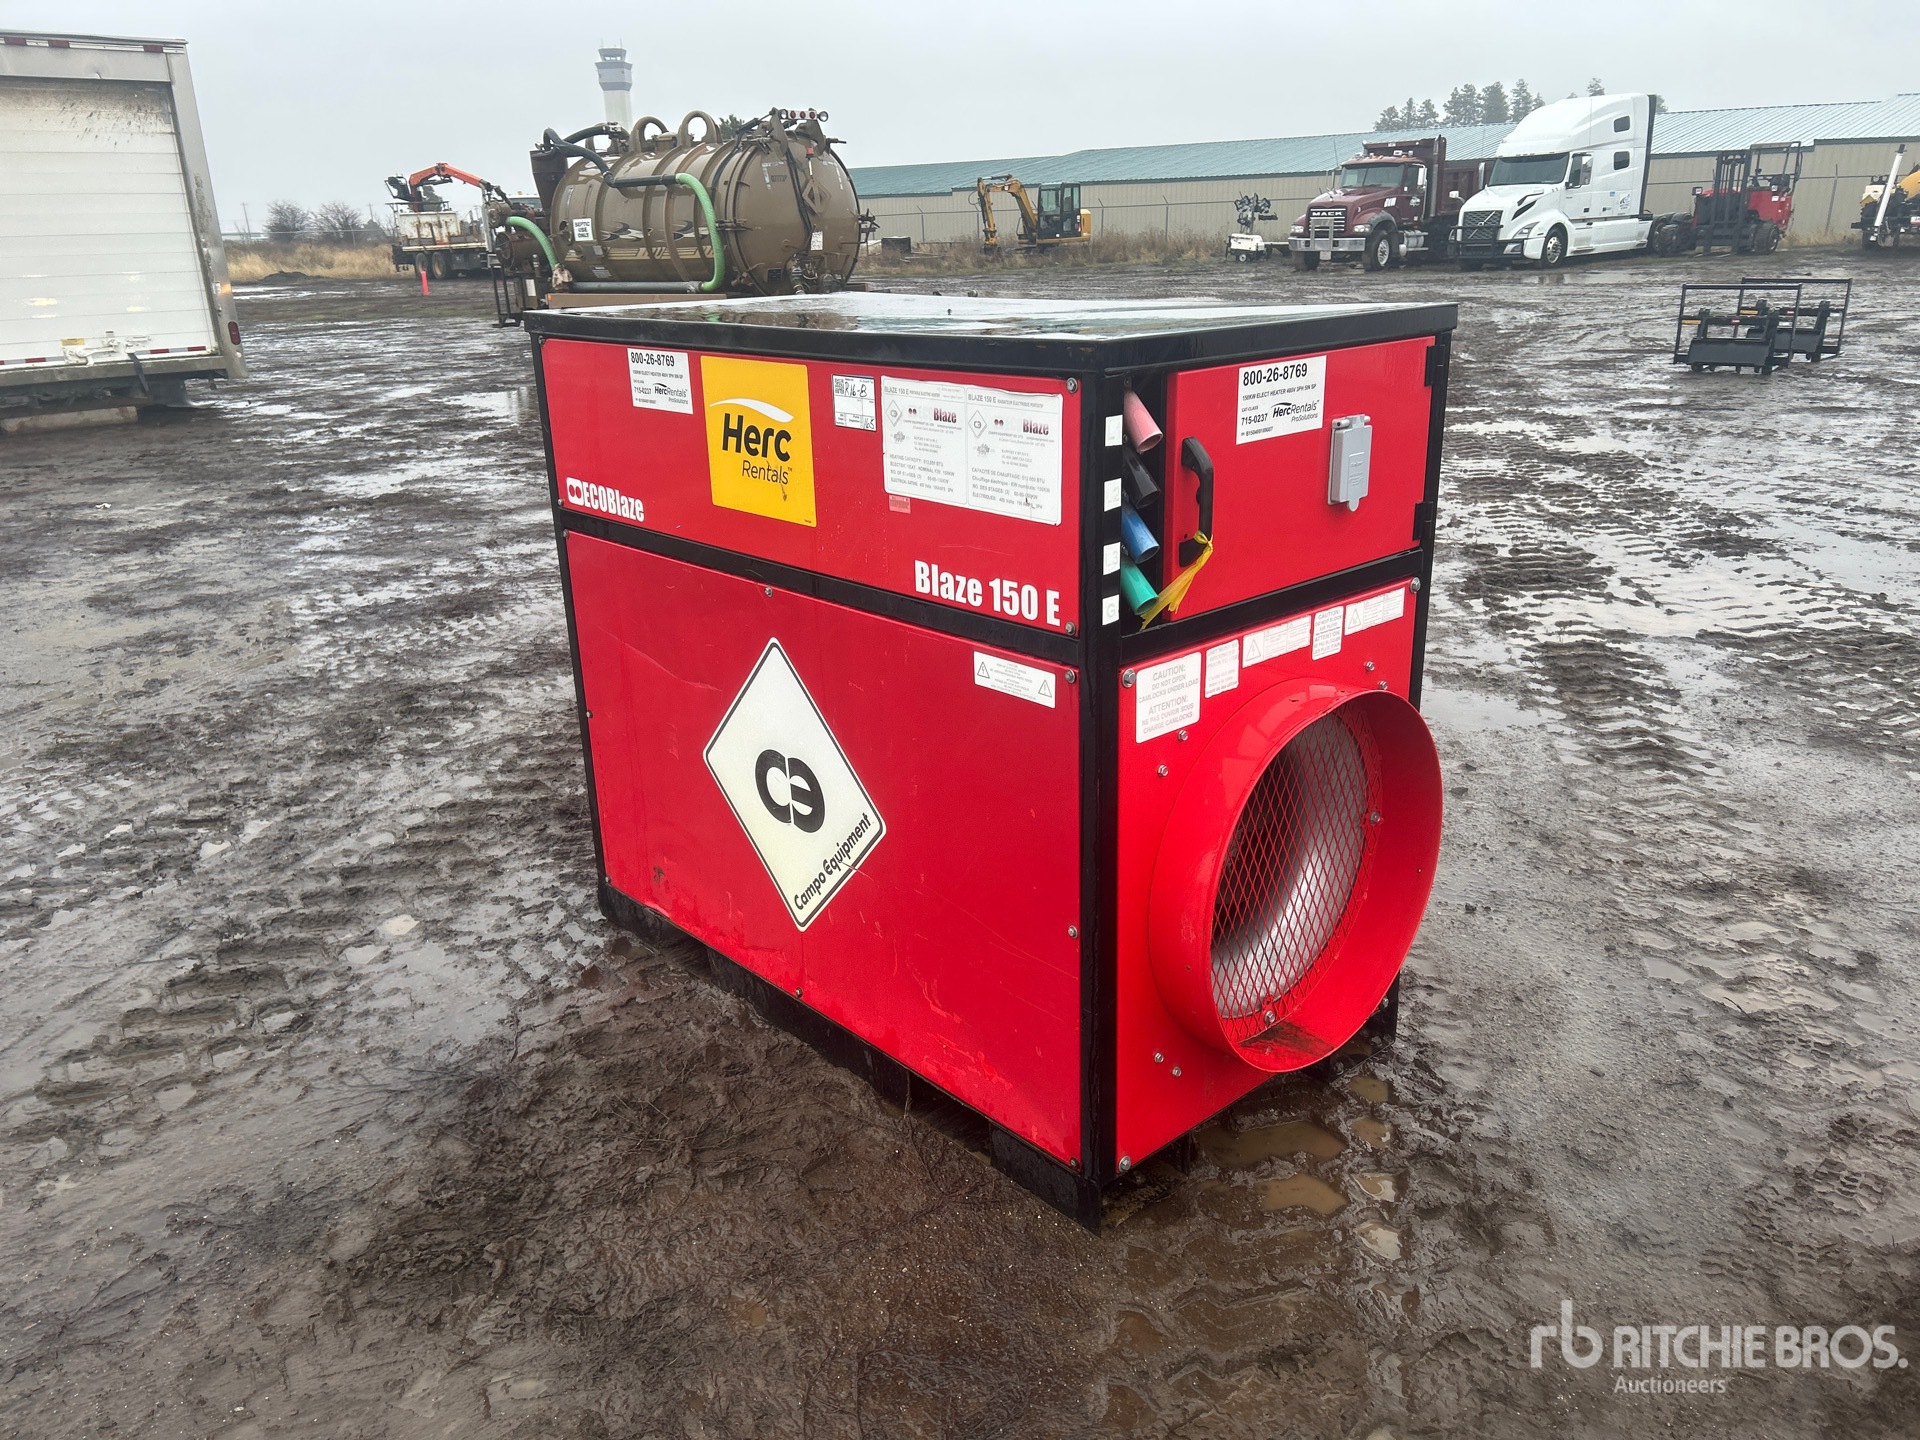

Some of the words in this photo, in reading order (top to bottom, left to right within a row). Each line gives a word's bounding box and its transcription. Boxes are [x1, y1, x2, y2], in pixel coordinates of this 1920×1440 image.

[631, 351, 675, 367] 800-26-8769
[1243, 363, 1308, 386] 800-26-8769
[884, 386, 898, 394] BLAZE
[968, 393, 984, 402] BLAZE
[984, 395, 993, 403] 150
[1256, 391, 1270, 399] ELECT
[1270, 388, 1286, 397] HEATER
[933, 408, 957, 424] Blaze
[1272, 402, 1318, 418] HercRentals
[1291, 413, 1318, 423] ProSolutions
[1022, 418, 1049, 436] Blaze
[1241, 413, 1269, 426] 715-0237
[722, 413, 791, 462] Herc
[742, 460, 788, 485] Rentals
[582, 480, 645, 522] ECOBlaze
[914, 559, 983, 607] Blaze
[989, 577, 1038, 621] 150
[1046, 589, 1061, 627] E
[1152, 664, 1186, 681] CAUTION:
[1152, 682, 1160, 690] DO
[1161, 678, 1171, 687] NOT
[1171, 674, 1186, 684] OPEN
[1138, 688, 1167, 704] CAMLOCKS
[1167, 682, 1185, 694] UNDER
[1185, 677, 1200, 688] LOAD
[1149, 695, 1189, 715] ATTENTION:
[1143, 721, 1165, 734] CHARGE
[794, 871, 826, 910] Campo
[823, 812, 871, 875] Equipment
